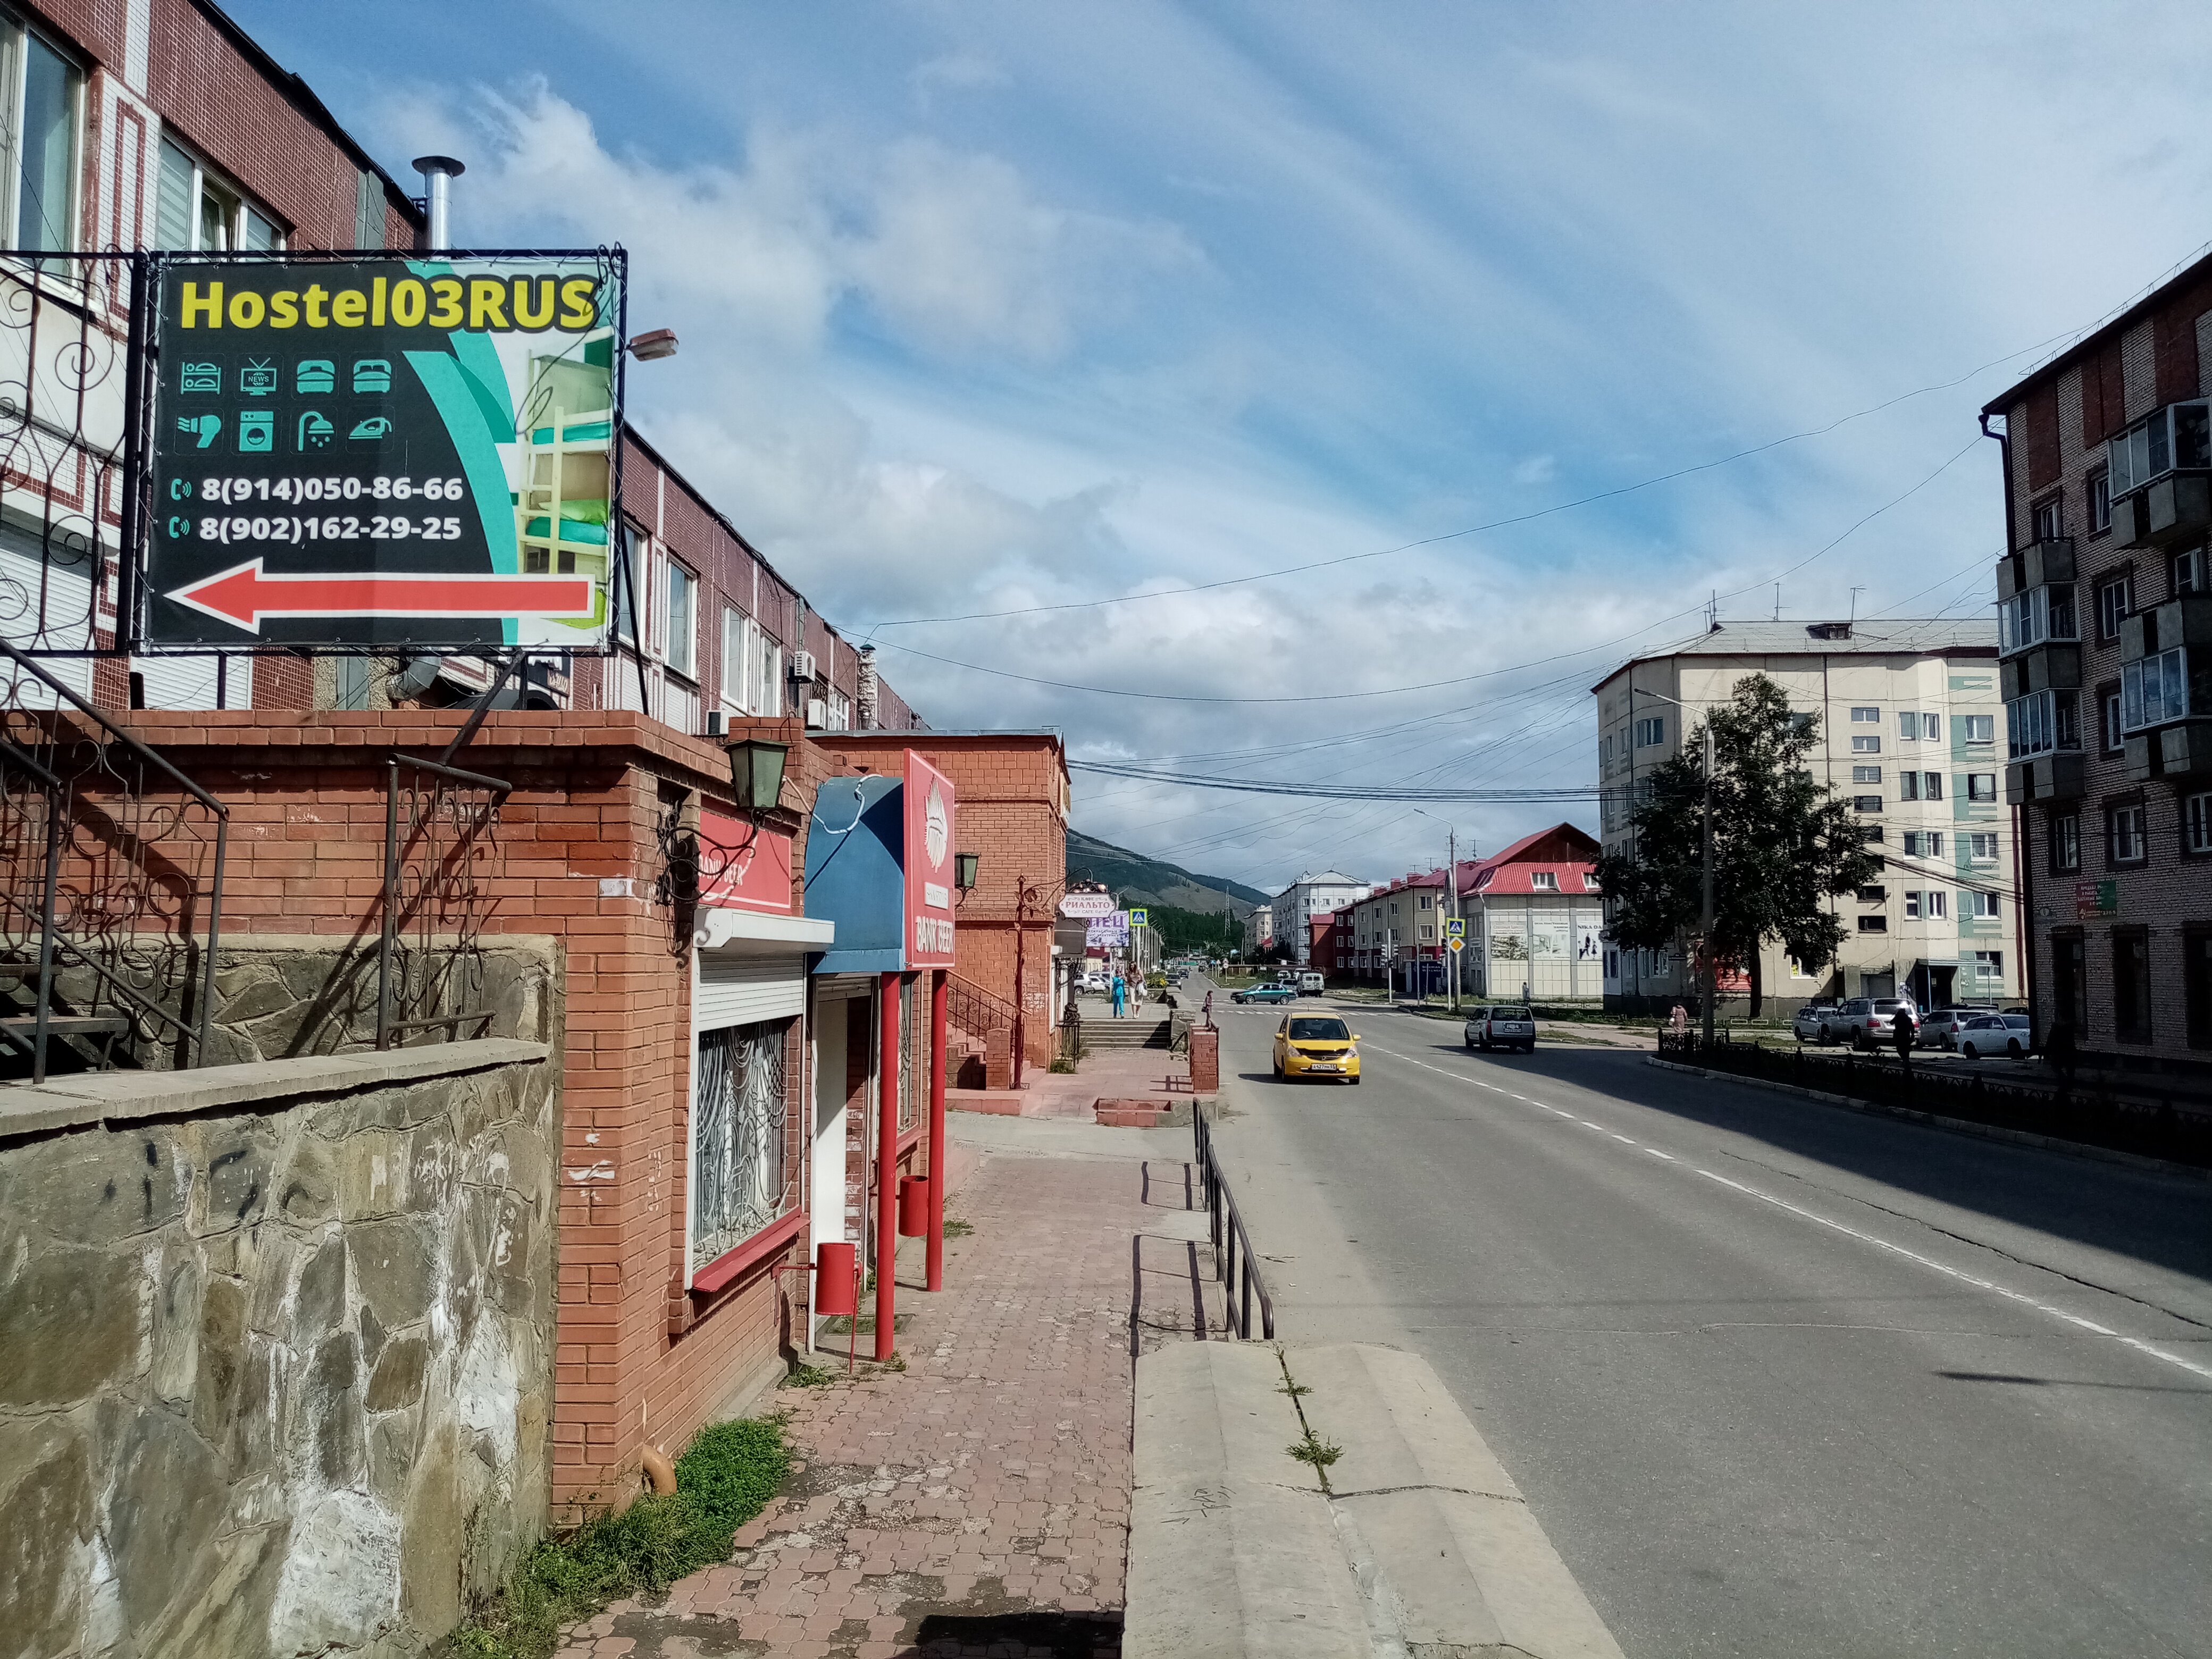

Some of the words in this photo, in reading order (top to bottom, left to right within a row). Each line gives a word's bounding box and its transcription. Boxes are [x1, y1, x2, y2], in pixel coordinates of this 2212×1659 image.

[181, 276, 595, 329] Hostel03RUS
[202, 476, 463, 505] 8(914)050-86-66
[199, 516, 462, 544] 8(902)162-29-25
[916, 916, 937, 954] BANK
